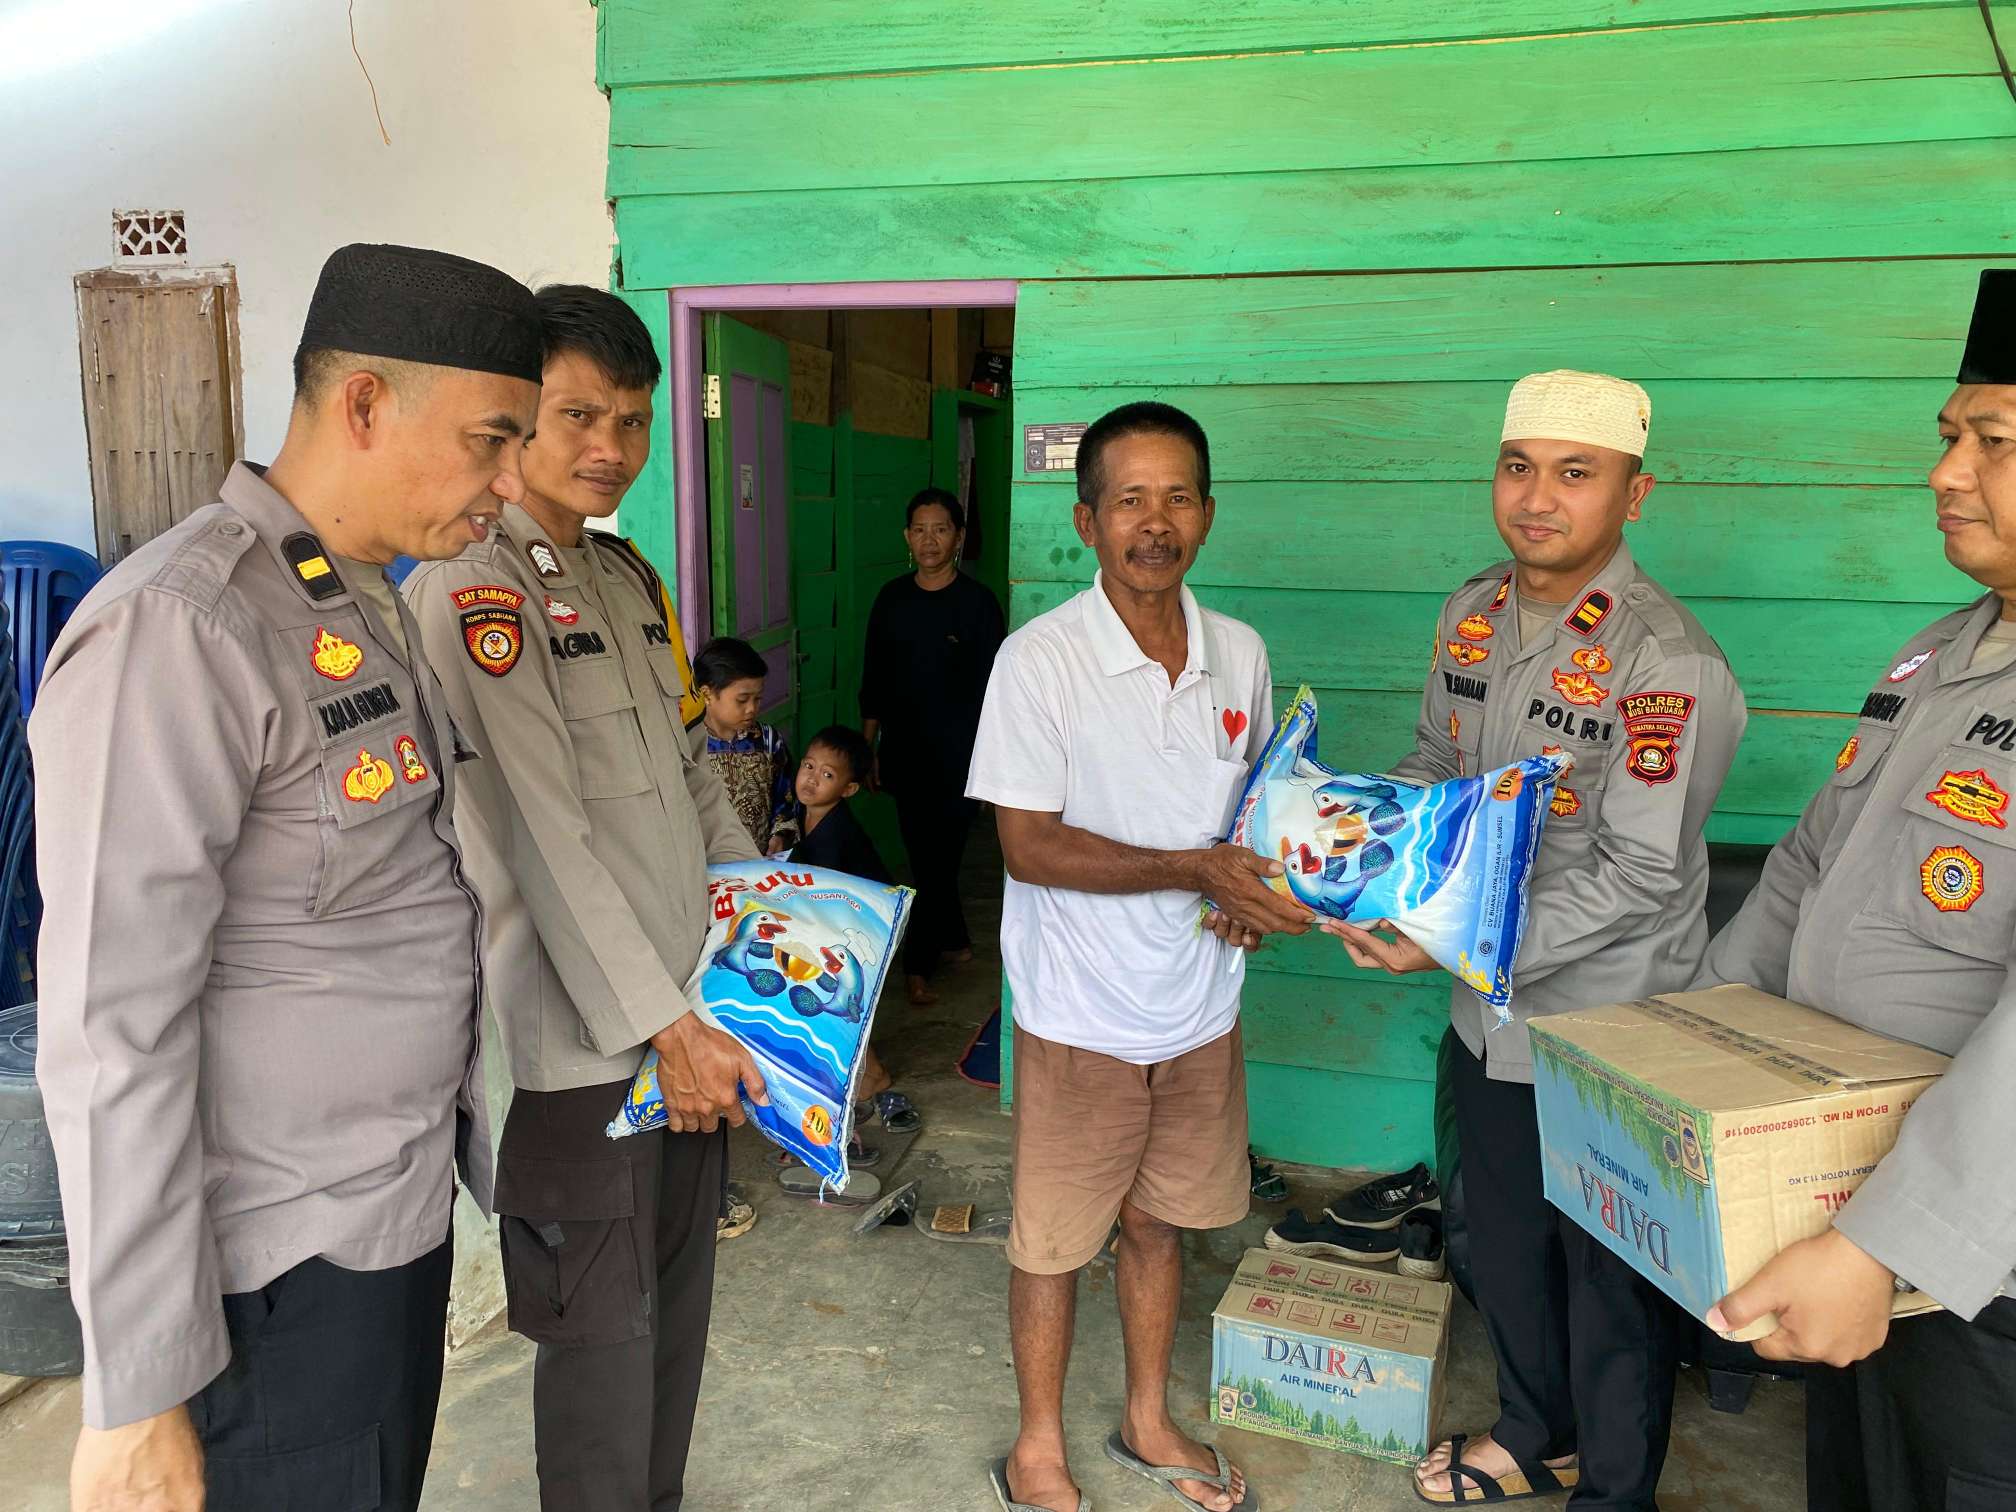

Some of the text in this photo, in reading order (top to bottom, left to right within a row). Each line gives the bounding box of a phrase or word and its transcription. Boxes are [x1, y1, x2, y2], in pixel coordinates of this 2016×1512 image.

[458, 588, 517, 606] SAT SAMAPTA
[465, 613, 486, 623] KORPS
[1626, 696, 1685, 710] POLRES
[1627, 705, 1686, 718] MUSI BANYUASIN
[1527, 698, 1612, 741] POLRI
[1496, 779, 1512, 798] 10
[810, 893, 862, 910] NUSANTARA
[1489, 895, 1497, 916] BUANA
[1820, 1112, 1840, 1123] MD.
[1843, 1110, 1853, 1121] RI
[1856, 1104, 1889, 1118] BPOM
[806, 1111, 825, 1133] 10
[1587, 1143, 1649, 1197] AIR MINERAL
[1821, 1170, 1850, 1180] KOTOR
[1576, 1161, 1672, 1277] DAIRA
[1343, 1313, 1355, 1324] 8
[1262, 1335, 1377, 1384] DAIRA
[1280, 1373, 1357, 1398] AIR MINERAL
